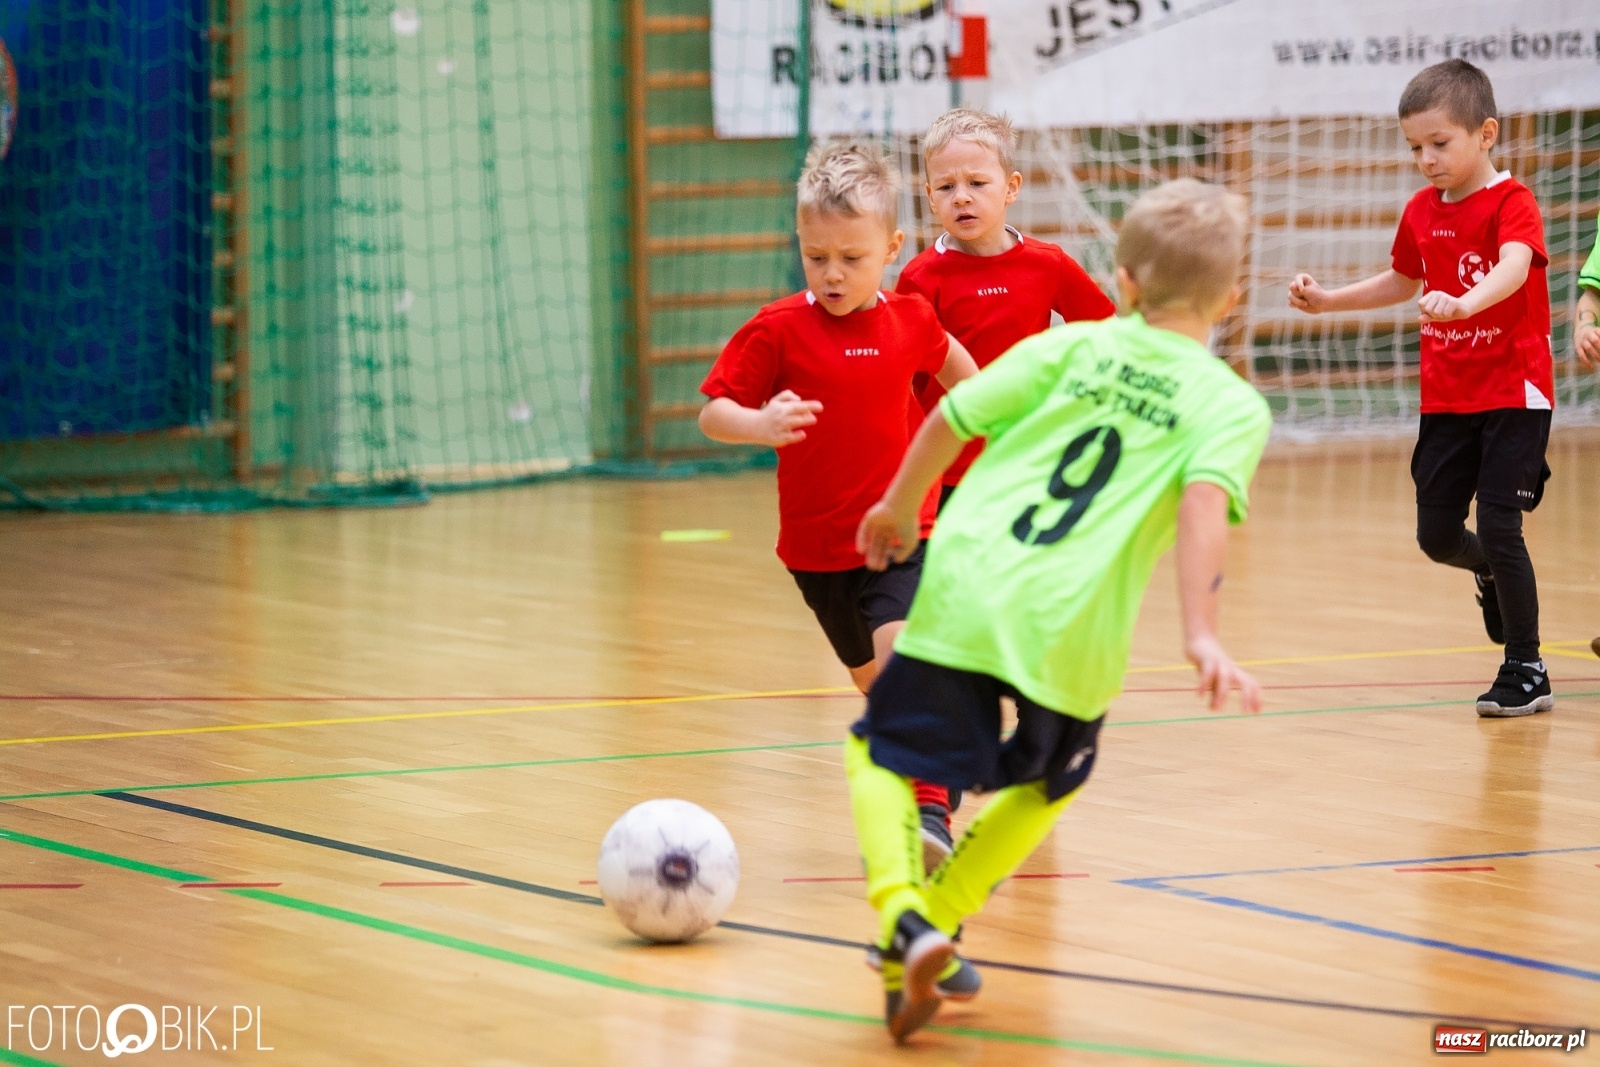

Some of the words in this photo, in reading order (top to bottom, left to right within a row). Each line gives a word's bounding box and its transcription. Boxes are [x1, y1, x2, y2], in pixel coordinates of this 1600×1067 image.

[1035, 0, 1172, 57] JES
[1272, 24, 1600, 65] www.osir-raciborz.
[1432, 229, 1456, 238] KIPSTA
[977, 286, 1009, 297] KIPSTA
[845, 348, 880, 357] KIPSTA
[1011, 425, 1122, 546] 9
